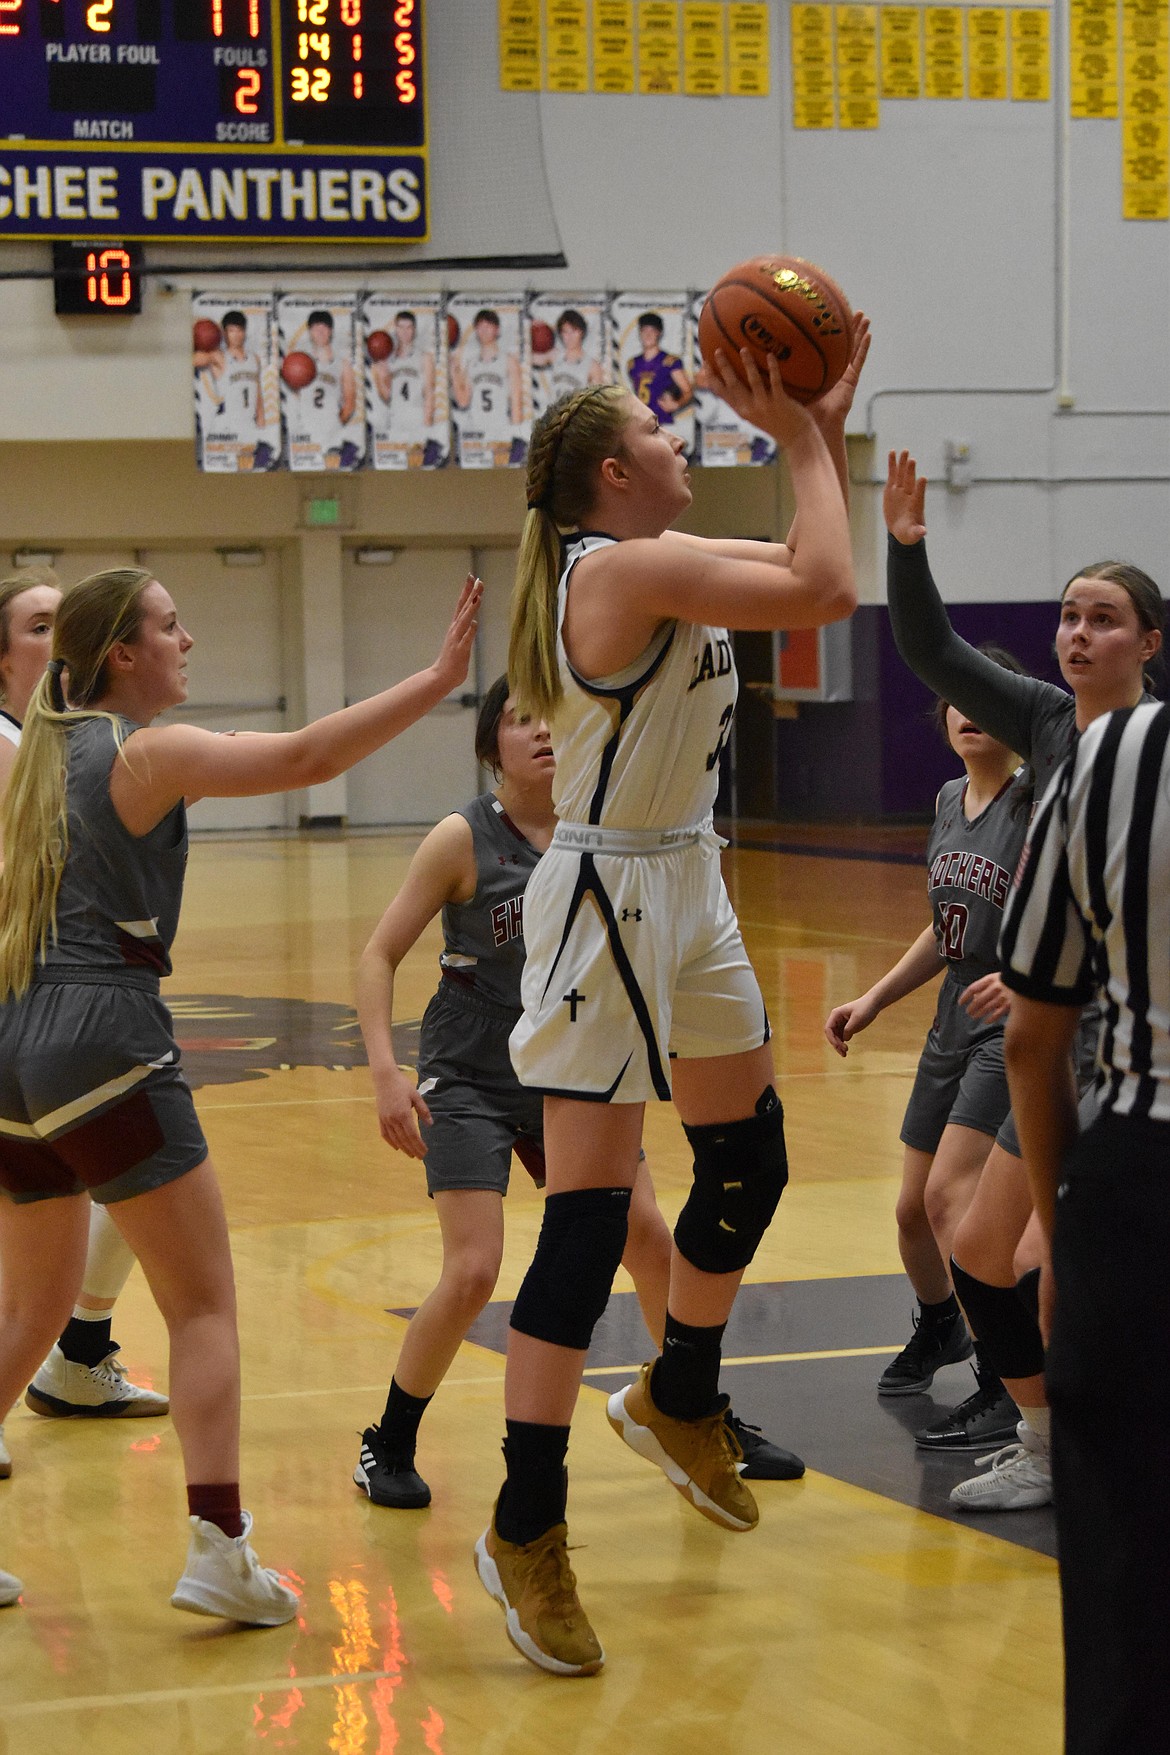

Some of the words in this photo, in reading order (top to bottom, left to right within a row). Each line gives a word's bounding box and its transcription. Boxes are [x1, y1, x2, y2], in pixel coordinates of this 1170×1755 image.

[298, 0, 329, 26] 12
[393, 0, 415, 28] 2
[46, 43, 111, 63] PLAYER
[117, 45, 160, 65] FOUL
[214, 47, 268, 67] FOULS
[298, 32, 330, 61] 14
[352, 34, 362, 62] 1
[394, 32, 415, 66] 5
[235, 69, 261, 114] 2
[291, 67, 331, 102] 32
[353, 72, 363, 99] 1
[395, 69, 416, 104] 5
[73, 119, 134, 139] MATCH
[215, 122, 270, 142] SCORE
[141, 167, 421, 223] PANTHERS
[86, 250, 131, 306] 10
[313, 387, 325, 410] 2
[400, 380, 409, 402] 4
[481, 389, 493, 412] 5
